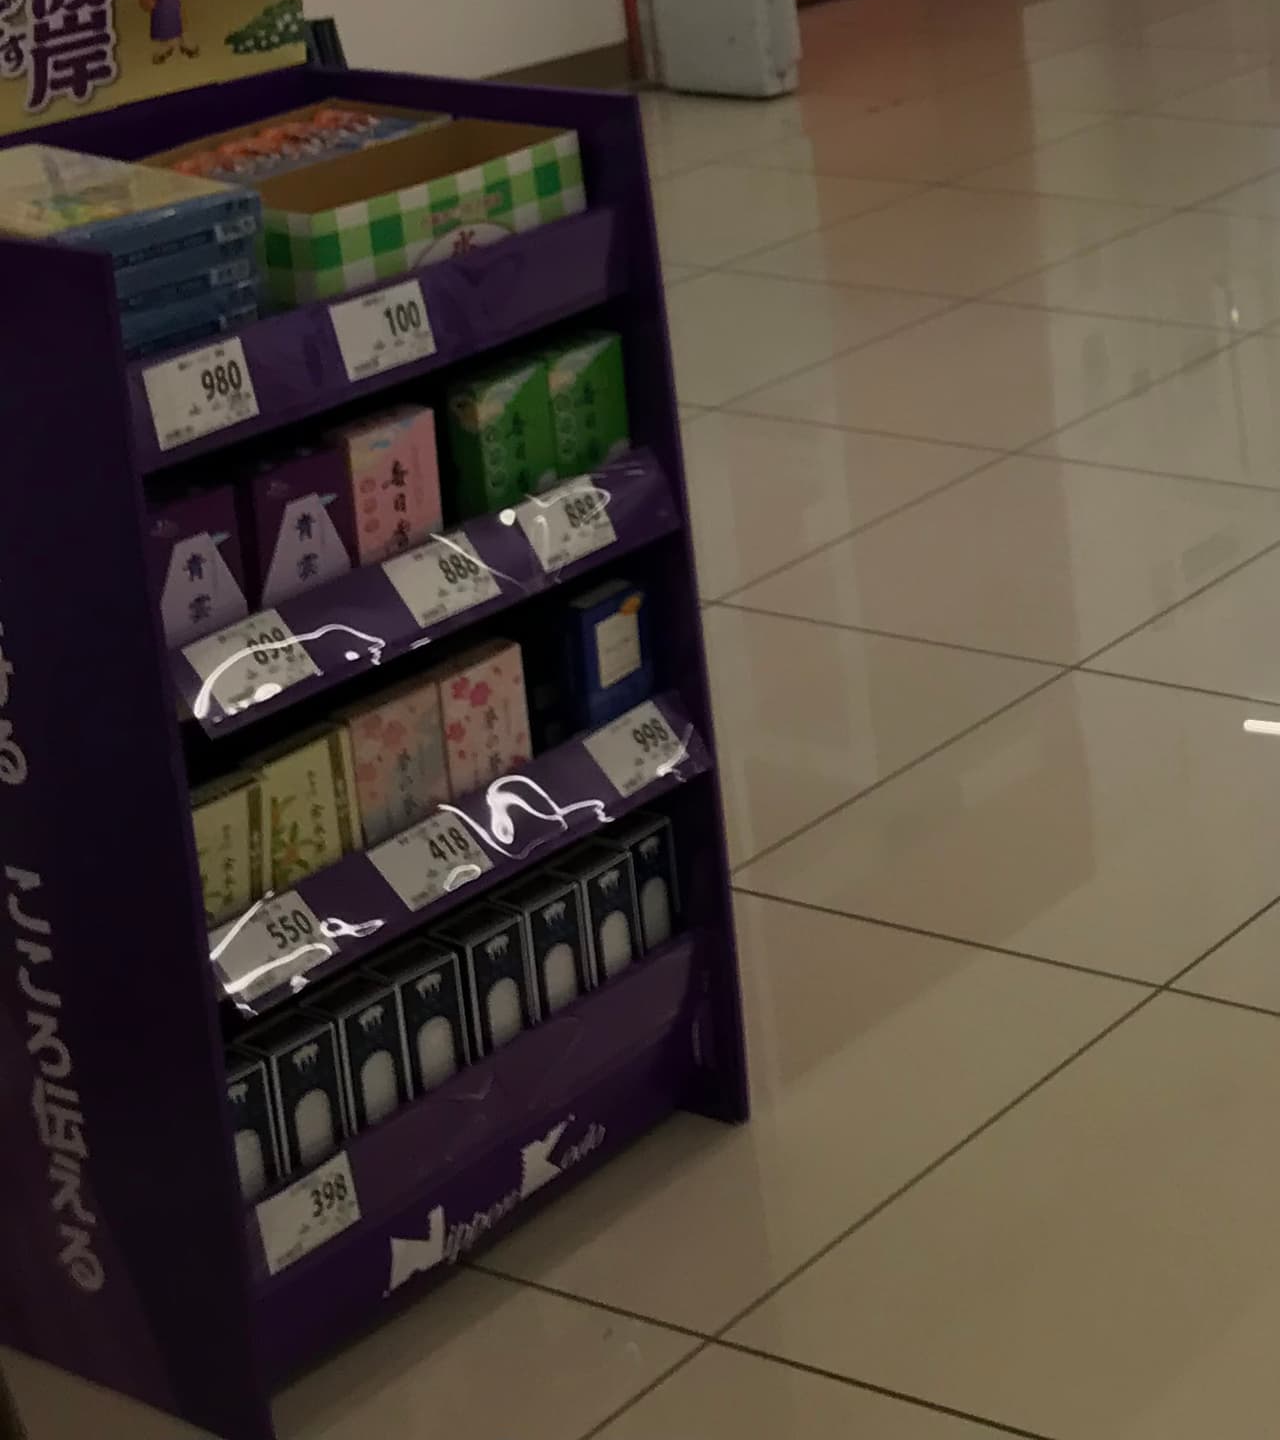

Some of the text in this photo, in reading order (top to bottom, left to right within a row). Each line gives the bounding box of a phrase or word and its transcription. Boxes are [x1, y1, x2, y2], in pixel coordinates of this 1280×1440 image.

[384, 300, 421, 336] 100
[201, 362, 242, 401] 980
[633, 718, 668, 752] 998
[427, 826, 470, 863] 418
[267, 910, 312, 949] 550
[310, 1174, 347, 1218] 398
